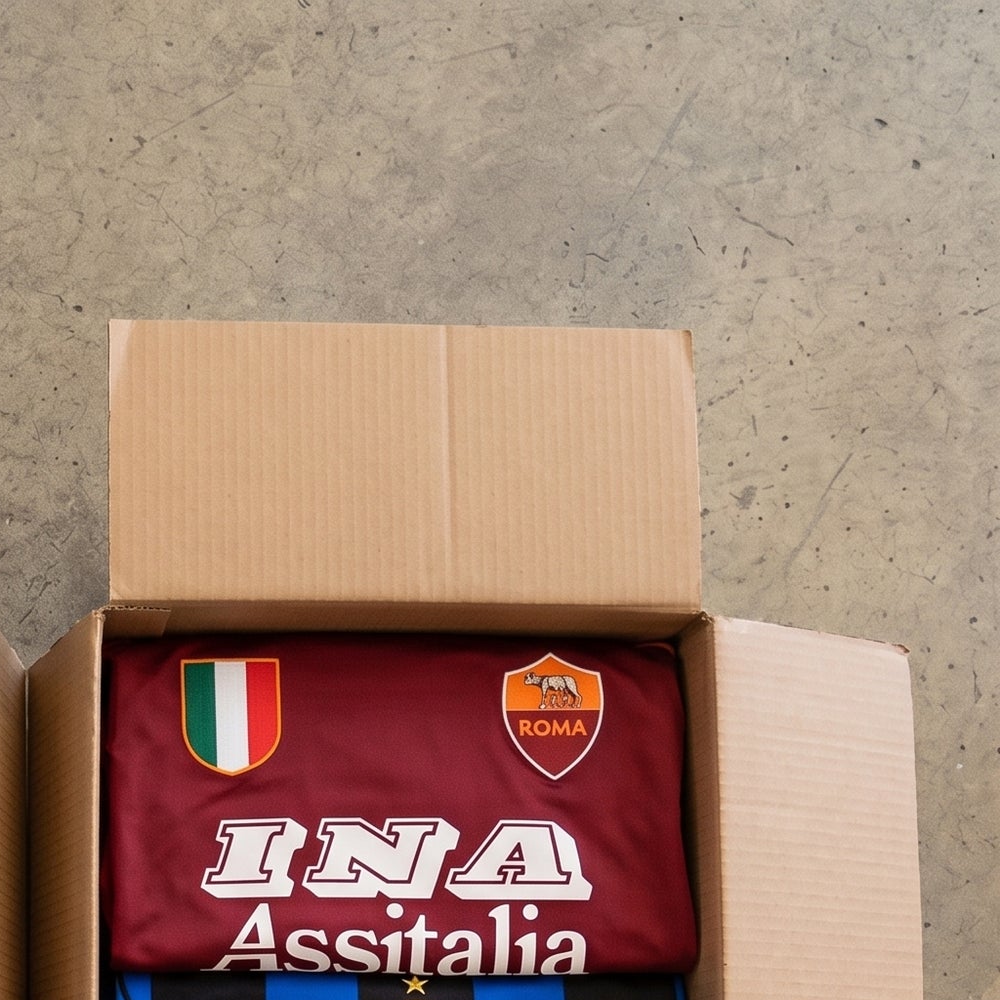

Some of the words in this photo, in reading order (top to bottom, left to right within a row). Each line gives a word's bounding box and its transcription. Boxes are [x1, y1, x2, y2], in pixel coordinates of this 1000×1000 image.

[519, 719, 588, 737] ROMA
[200, 817, 593, 901] INA
[200, 903, 590, 976] Assitalia
